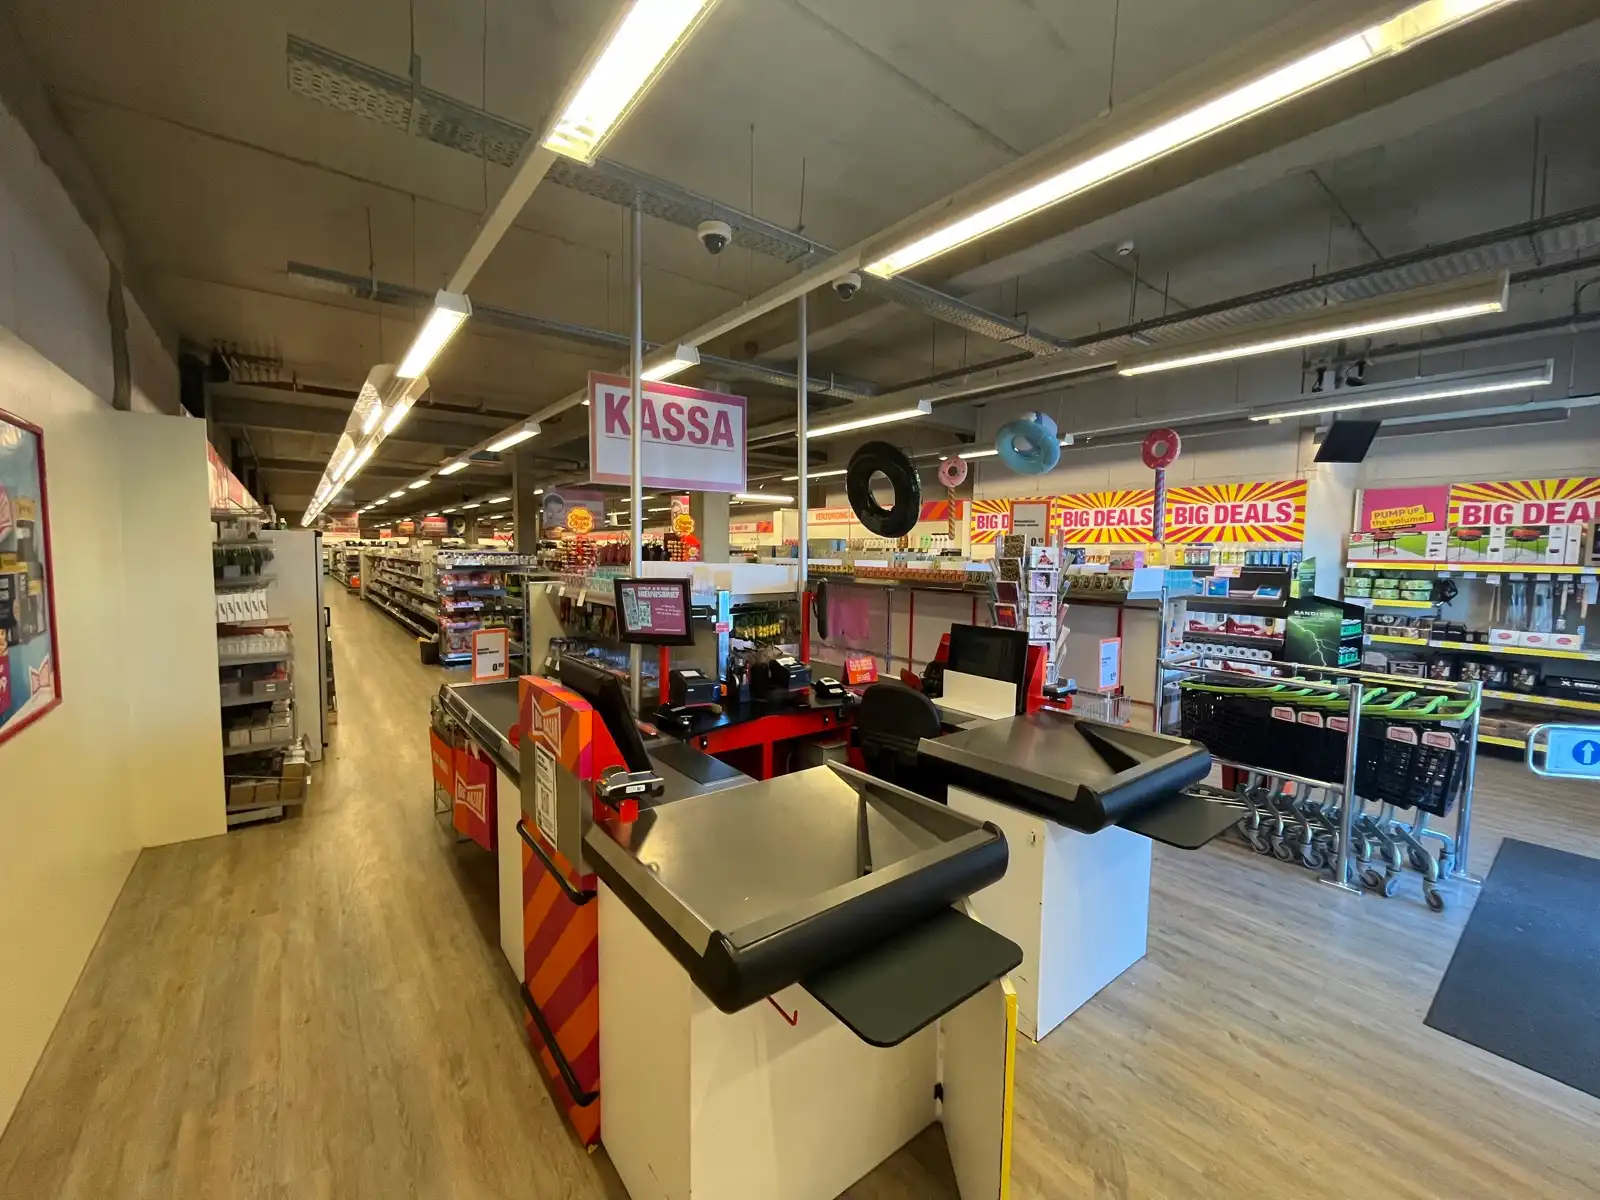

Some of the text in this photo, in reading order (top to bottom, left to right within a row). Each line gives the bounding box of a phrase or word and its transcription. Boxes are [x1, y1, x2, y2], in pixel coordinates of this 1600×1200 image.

[604, 392, 734, 448] KASSA
[977, 514, 998, 529] BIG
[1063, 507, 1152, 528] BIG DEALS
[1174, 502, 1293, 525] BIG DEALS
[1372, 518, 1388, 527] the
[1373, 507, 1420, 519] PUMP UP
[1462, 501, 1600, 525] BIG DEA
